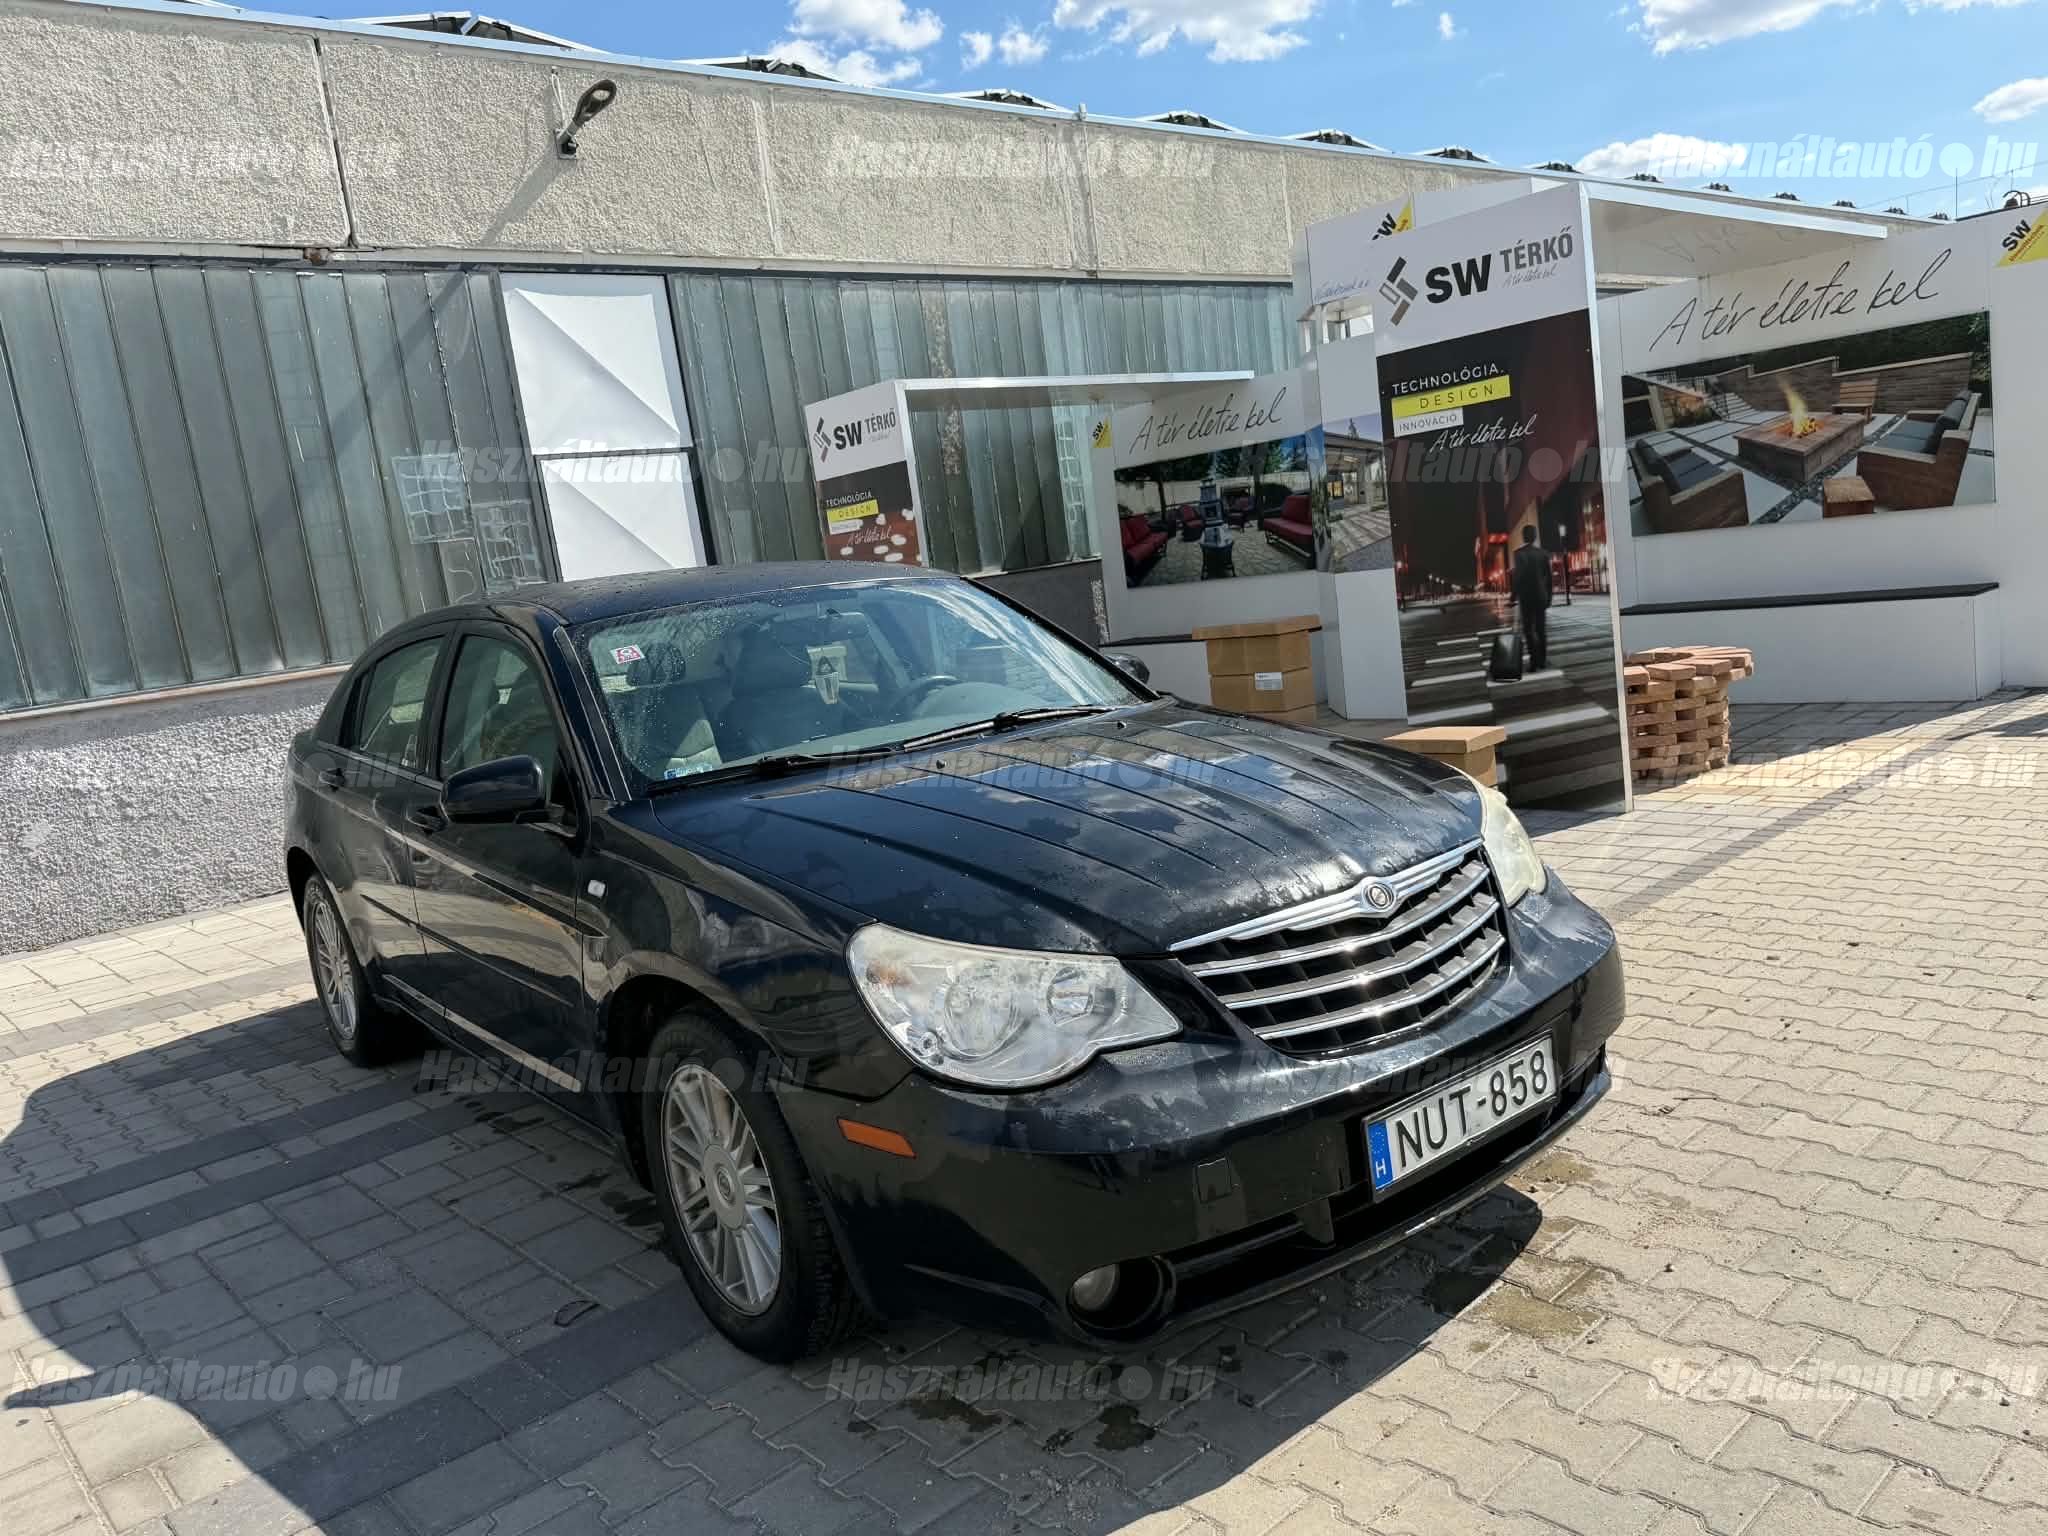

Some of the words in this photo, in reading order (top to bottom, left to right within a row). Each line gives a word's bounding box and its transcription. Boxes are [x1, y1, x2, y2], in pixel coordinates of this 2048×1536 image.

[1372, 212, 1397, 240] W
[2002, 219, 2031, 251] SW
[1425, 253, 1492, 304] SW
[1499, 225, 1573, 273] TÉRKŐ
[1649, 297, 1698, 351] A
[1701, 292, 1755, 341] tér
[1759, 260, 1858, 329] életre
[1866, 247, 1952, 314] kel
[1419, 384, 1495, 409] DESIGN
[833, 420, 862, 450] SW
[1129, 415, 1154, 455] A
[1244, 386, 1287, 431] kel
[1396, 1050, 1548, 1168] NUT-858
[1375, 1160, 1386, 1179] H
